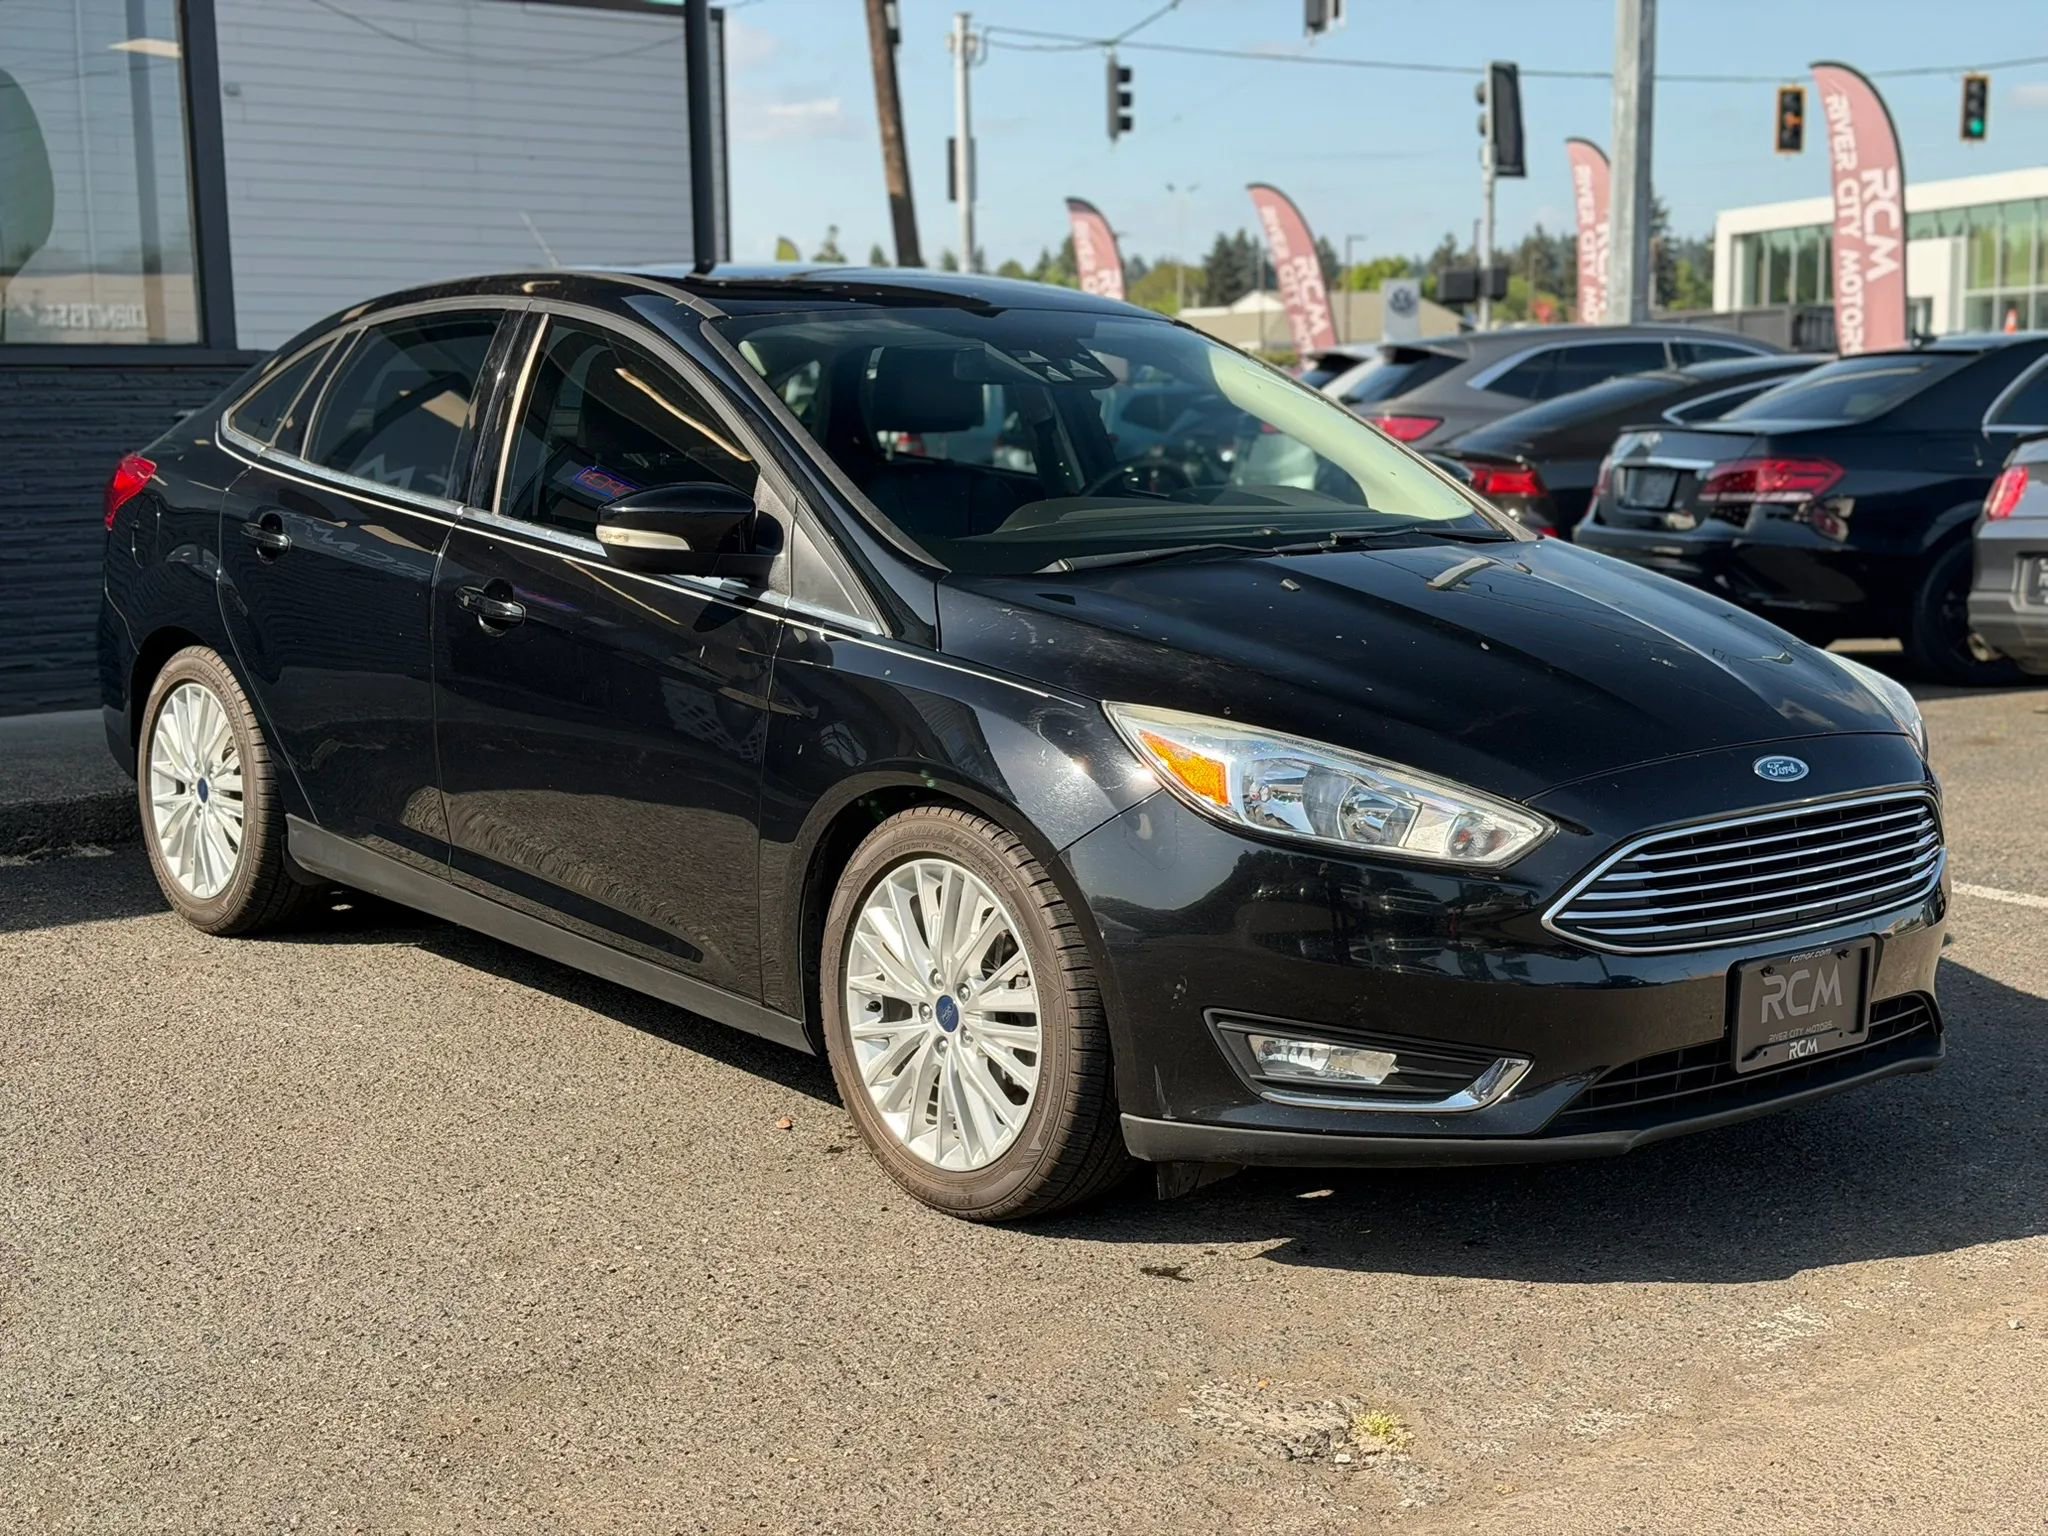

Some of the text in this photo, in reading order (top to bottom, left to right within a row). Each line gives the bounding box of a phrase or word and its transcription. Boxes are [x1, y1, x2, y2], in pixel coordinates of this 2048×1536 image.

[1824, 94, 1858, 171] RIVER
[1837, 178, 1861, 238] CITY
[1860, 166, 1900, 283] RCM
[1766, 760, 1798, 777] Ford
[1760, 962, 1843, 1024] RCM
[1788, 1038, 1818, 1060] RCM
